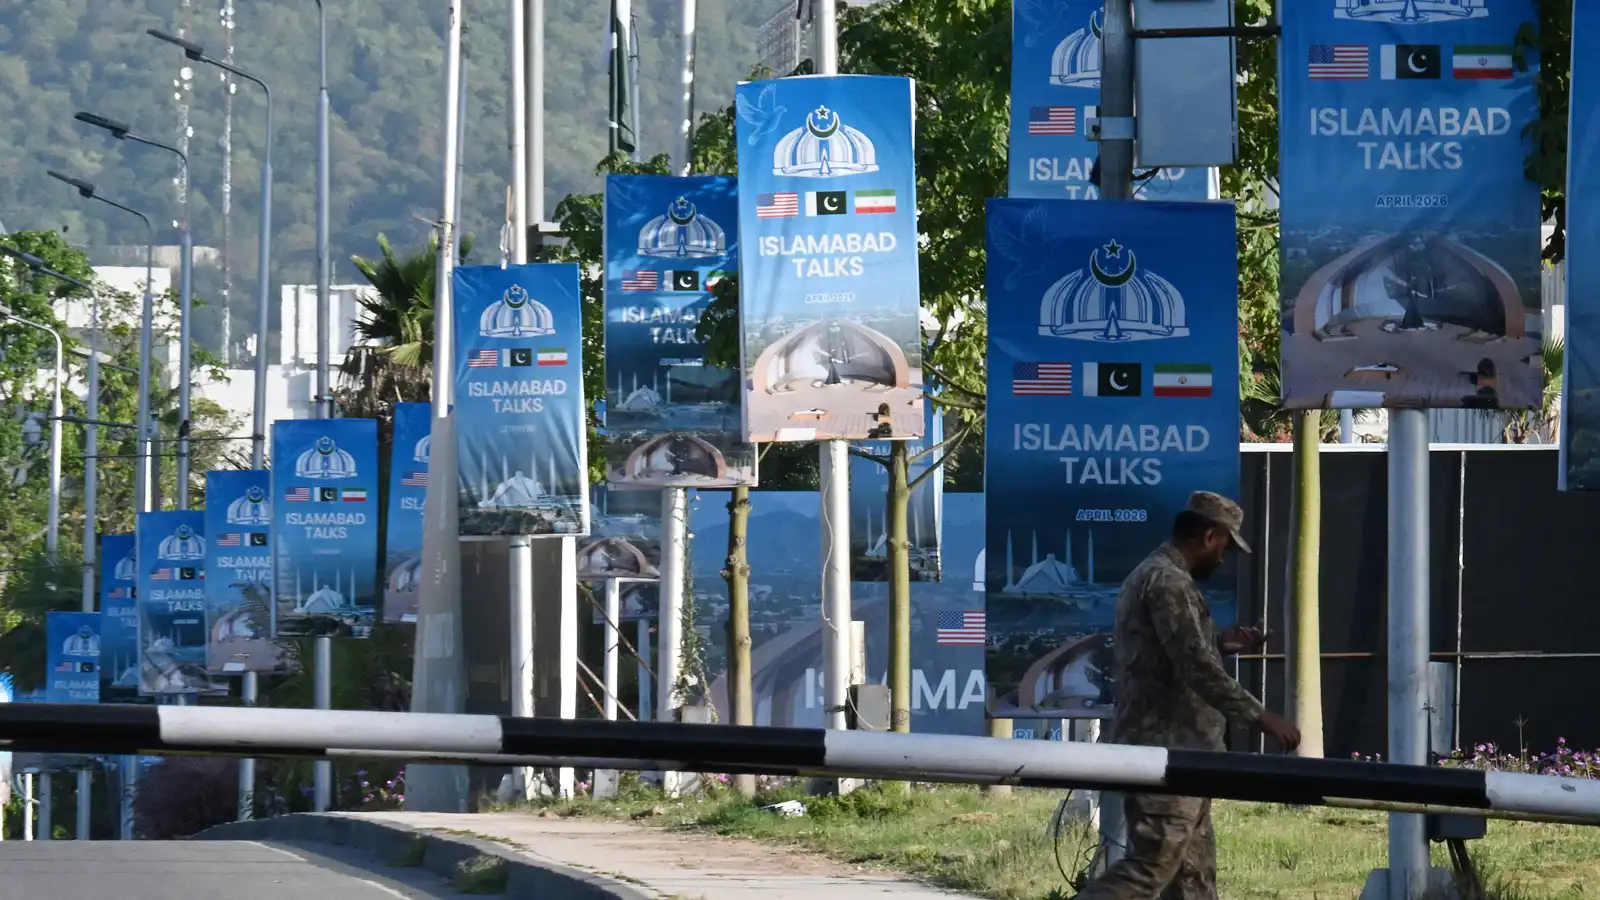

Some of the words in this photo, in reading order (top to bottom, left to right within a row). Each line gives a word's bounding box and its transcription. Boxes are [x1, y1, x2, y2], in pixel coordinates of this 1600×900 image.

[1310, 106, 1512, 136] ISLAMABAD
[1357, 141, 1464, 170] TALKS
[1375, 194, 1414, 208] APRIL
[1415, 194, 1448, 208] 2026
[758, 231, 897, 257] ISLAMABAD
[791, 255, 865, 279] TALKS
[649, 326, 711, 344] TALK
[468, 379, 567, 398] ISLAMABAD
[491, 397, 544, 413] TALKS
[1013, 423, 1211, 452] ISLAMABAD
[1059, 456, 1163, 486] TALKS
[285, 512, 367, 526] ISLAMABAD
[1076, 509, 1113, 522] APRIL
[1115, 509, 1148, 522] 2026
[304, 526, 348, 540] TALKS
[167, 600, 204, 612] TALKS
